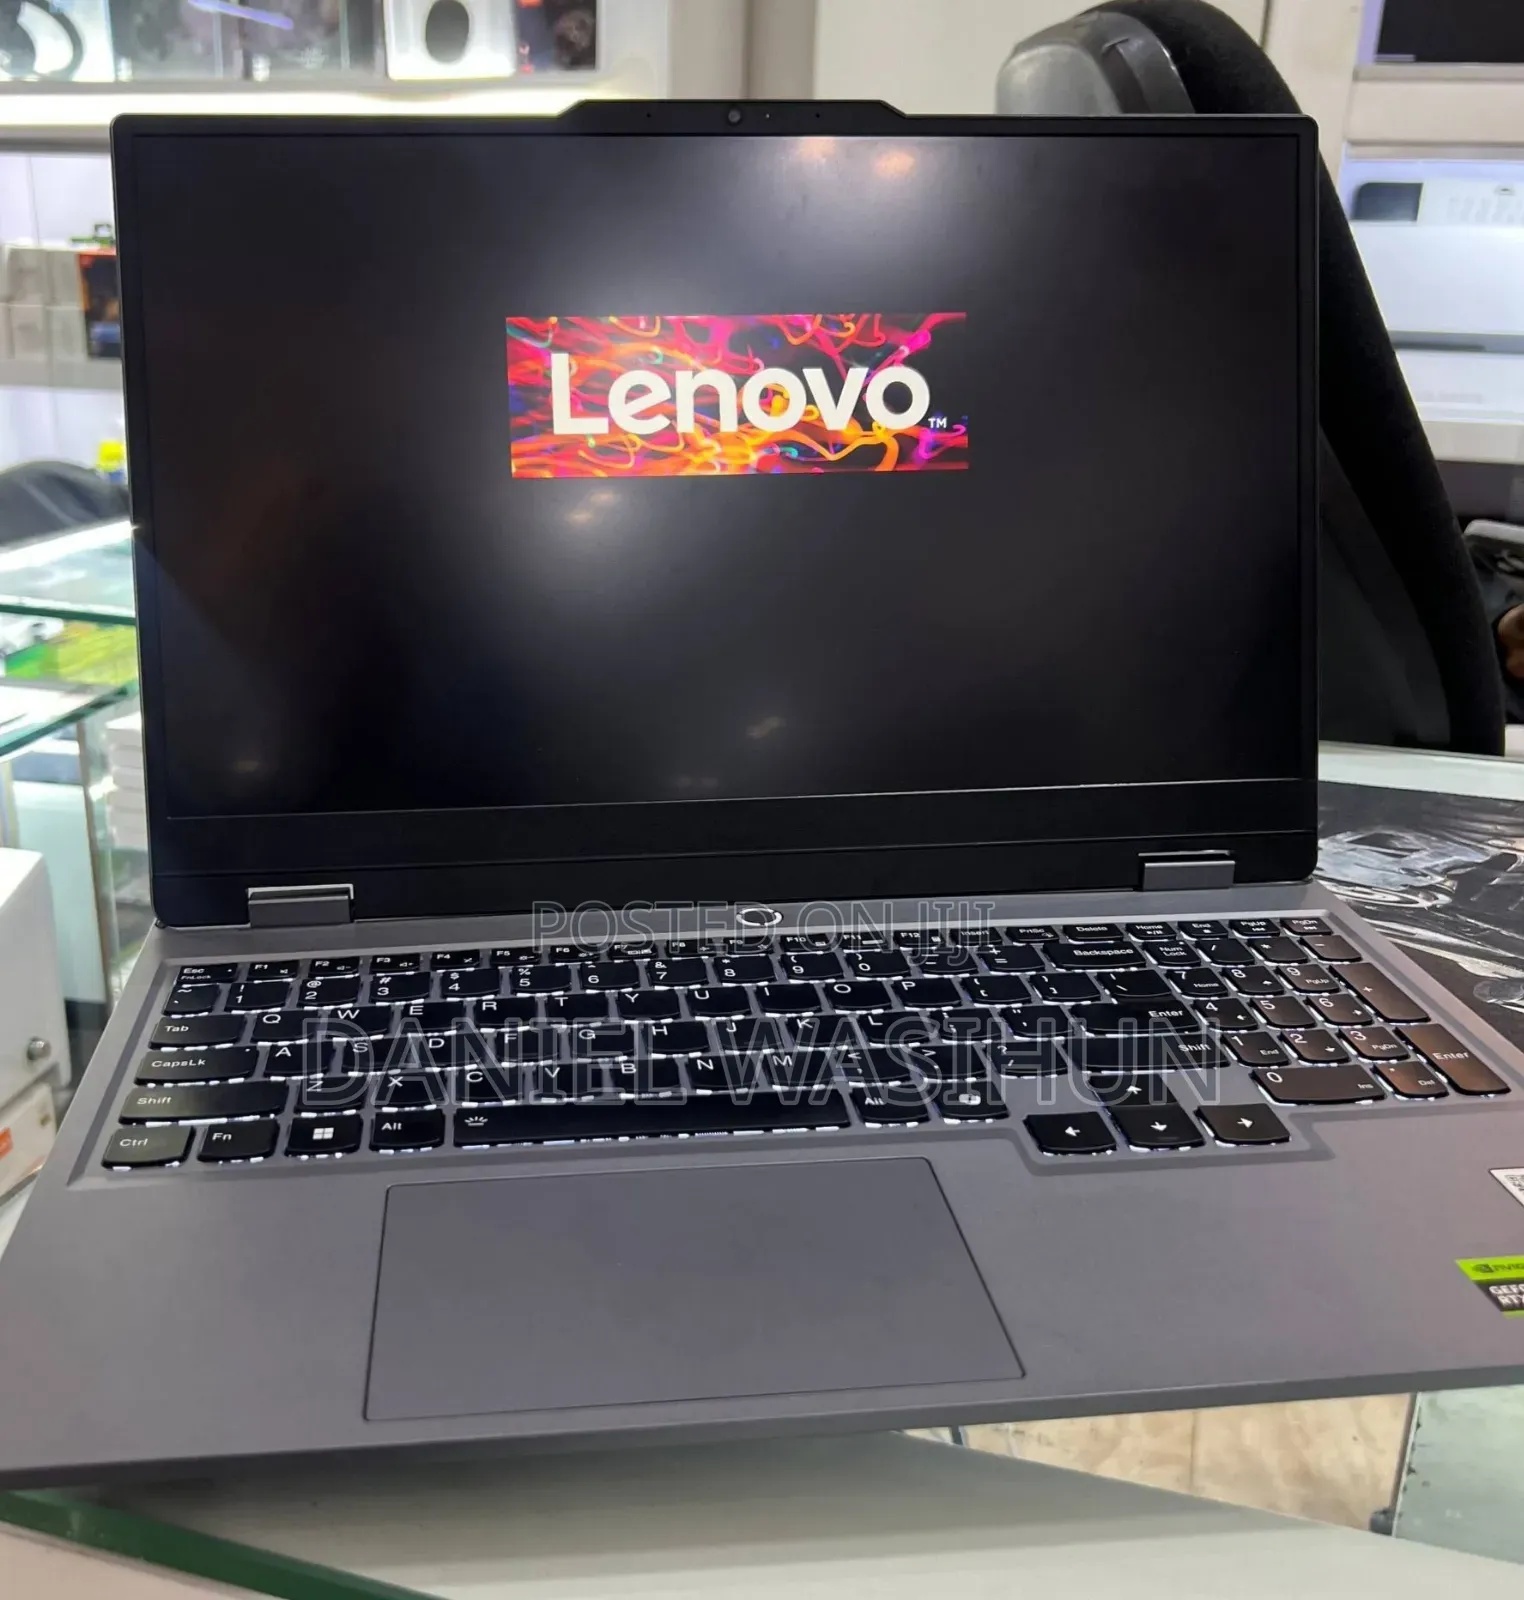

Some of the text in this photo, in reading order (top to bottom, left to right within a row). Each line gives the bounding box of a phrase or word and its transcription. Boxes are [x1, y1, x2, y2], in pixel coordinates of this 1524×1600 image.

[551, 353, 930, 435] Lenovo
[1074, 948, 1134, 956] Backspace
[518, 968, 531, 976] %
[724, 969, 736, 977] 8
[792, 966, 804, 974] 9
[1231, 969, 1247, 978] 8
[1286, 967, 1301, 976] 9
[450, 972, 460, 980] $
[588, 976, 600, 984] 6
[656, 972, 668, 980] 7
[1175, 971, 1186, 980] 7
[448, 983, 460, 991] 4
[519, 978, 531, 987] 5
[902, 981, 916, 990] P
[834, 984, 851, 994] O
[305, 992, 318, 1000] 2
[625, 994, 640, 1003] Y
[694, 990, 710, 1000] U
[482, 1002, 497, 1011] R
[554, 997, 569, 1007] T
[1206, 1002, 1218, 1012] 4
[1260, 1000, 1276, 1010] 5
[1319, 998, 1334, 1008] 6
[338, 1009, 360, 1019] W
[409, 1006, 424, 1016] E
[1148, 1010, 1184, 1018] Enter
[262, 1014, 281, 1024] Q
[797, 1019, 813, 1029] K
[868, 1016, 883, 1026] L
[652, 1026, 669, 1036] H
[726, 1022, 737, 1033] J
[504, 1034, 517, 1044] F
[579, 1030, 596, 1040] G
[1290, 1034, 1307, 1044] 2
[1350, 1030, 1367, 1041] 3
[428, 1038, 445, 1049] D
[1232, 1036, 1244, 1046] 1
[276, 1047, 292, 1057] A
[352, 1042, 369, 1053] S
[1178, 1044, 1211, 1052] Shift
[773, 1056, 792, 1066] M
[1433, 1052, 1470, 1061] Enter
[152, 1059, 206, 1068] CapsLk
[621, 1063, 637, 1074] B
[697, 1059, 714, 1070] N
[466, 1072, 483, 1082] C
[544, 1067, 560, 1078] V
[1266, 1072, 1283, 1083] 0
[306, 1080, 324, 1091] Z
[388, 1076, 404, 1087] X
[137, 1096, 172, 1105] Shift
[382, 1122, 402, 1130] Alt
[212, 1132, 233, 1141] Fn
[120, 1138, 149, 1147] Ctrl
